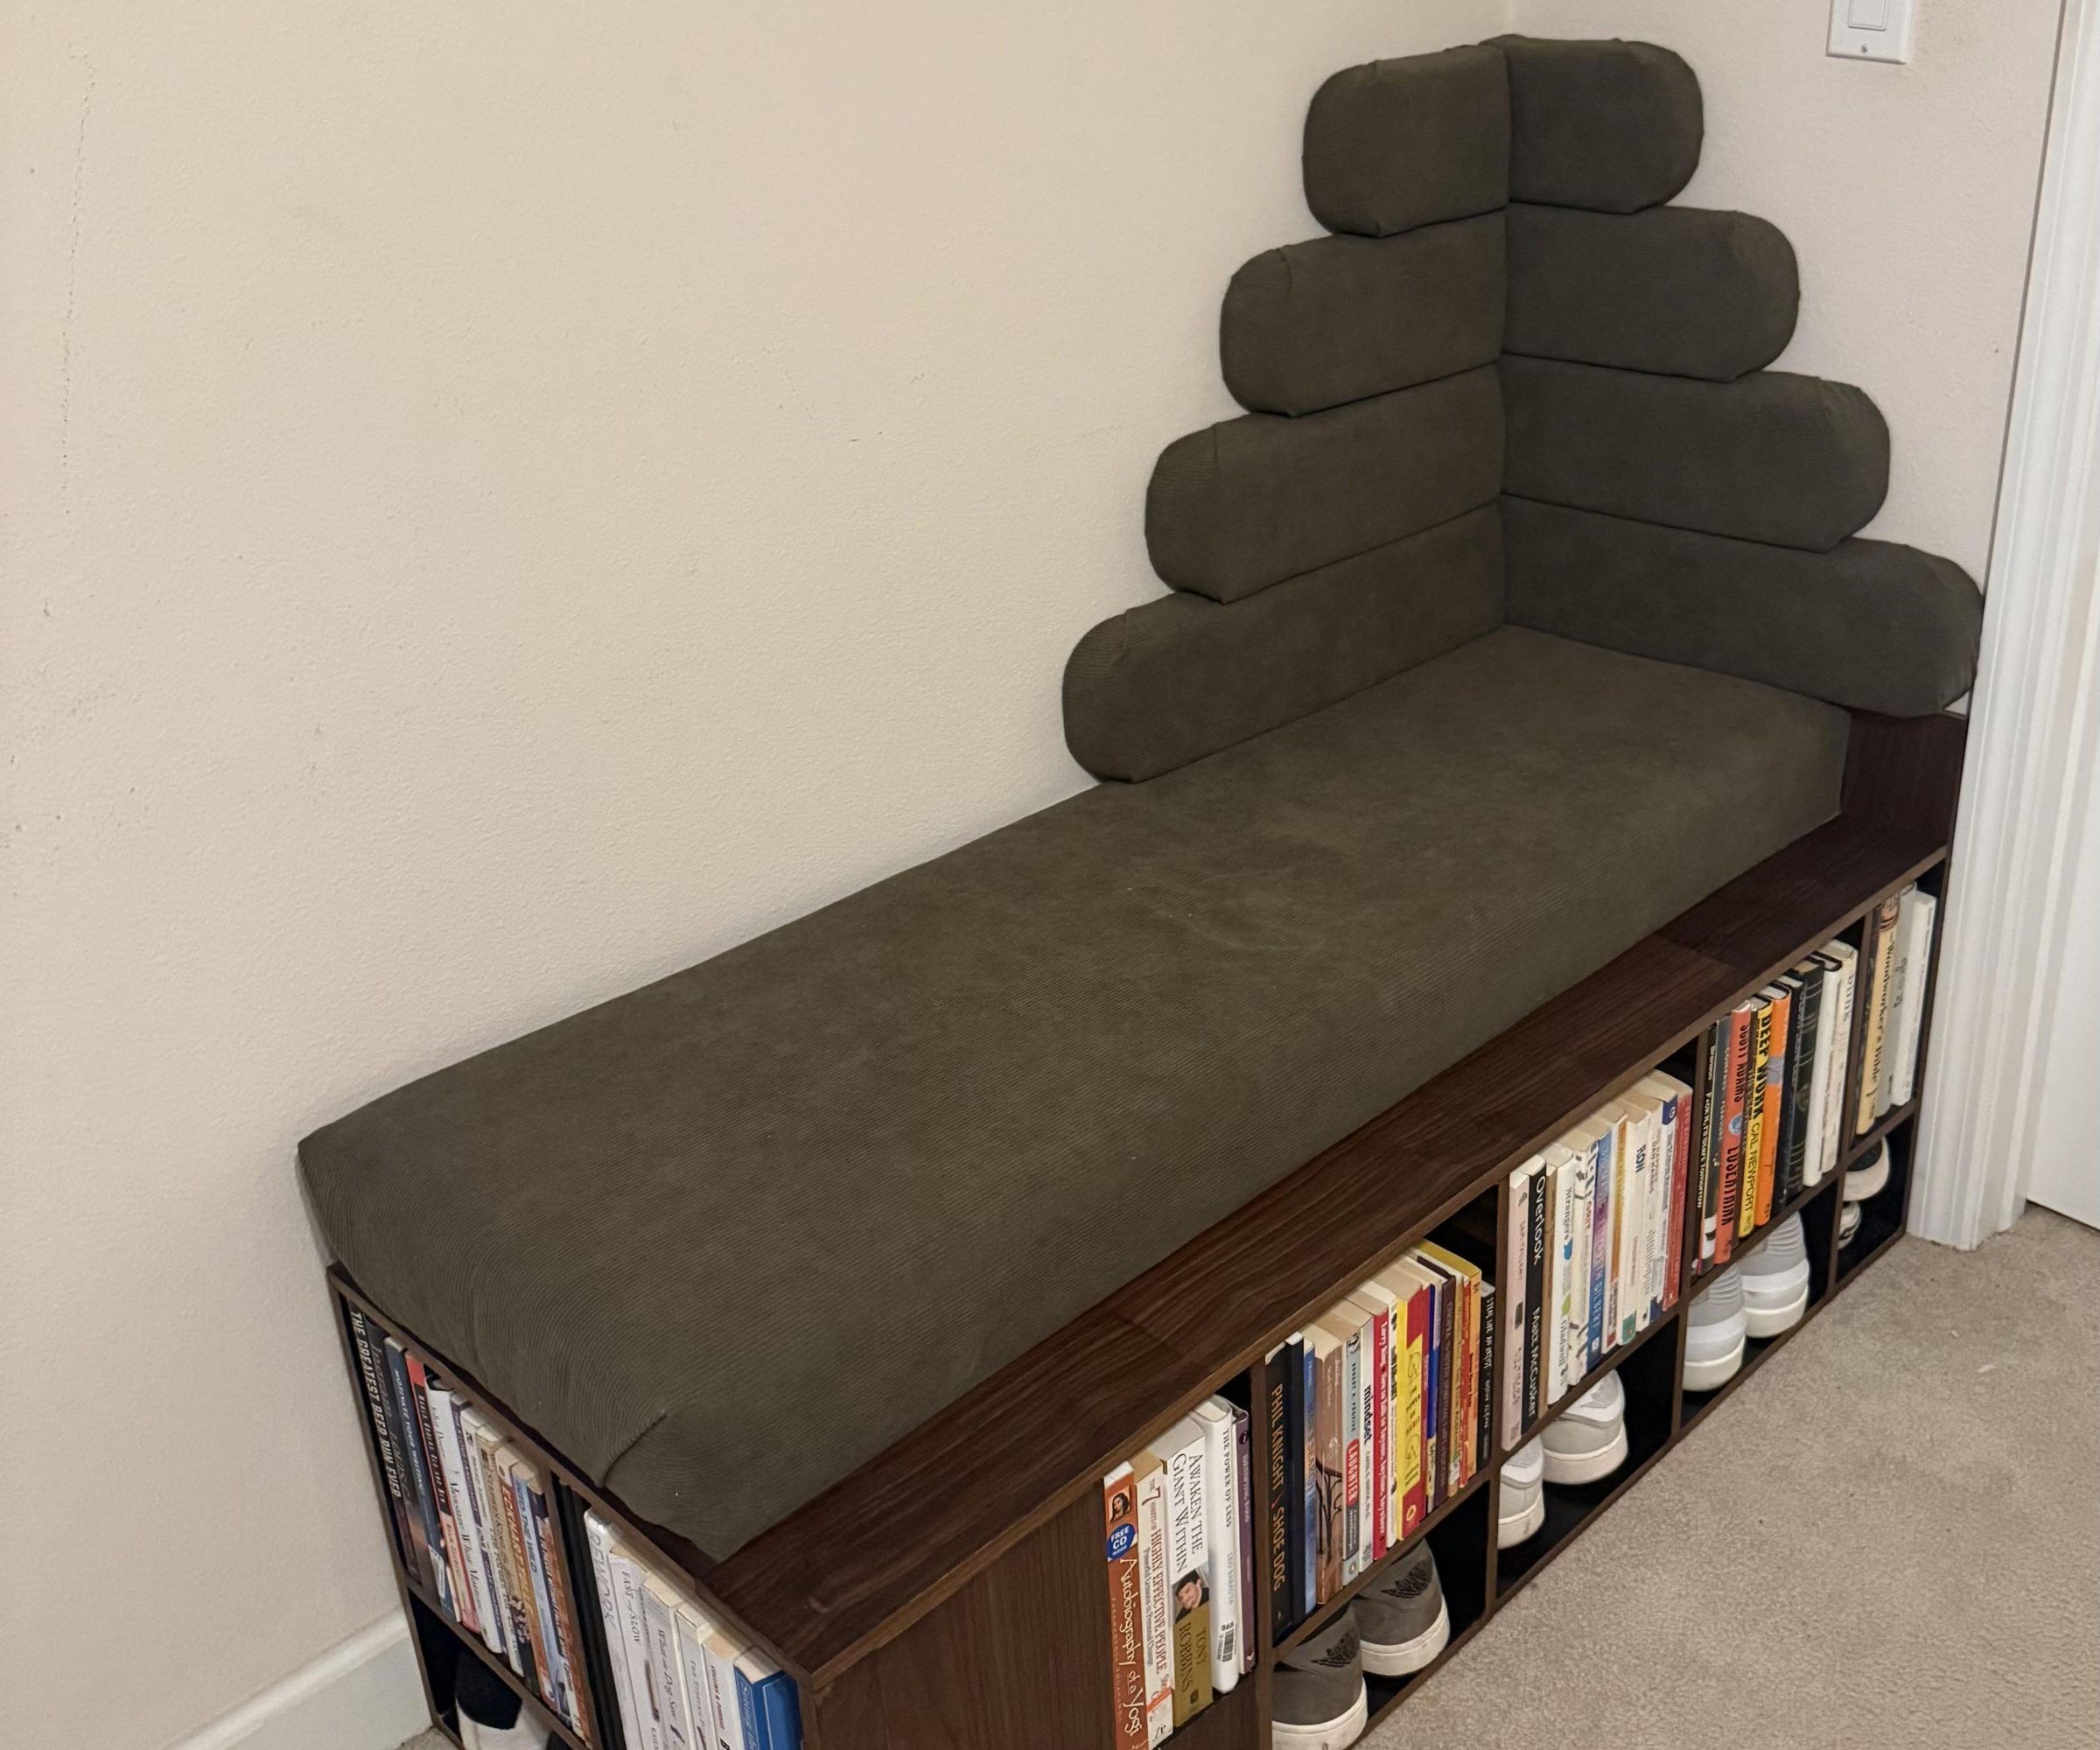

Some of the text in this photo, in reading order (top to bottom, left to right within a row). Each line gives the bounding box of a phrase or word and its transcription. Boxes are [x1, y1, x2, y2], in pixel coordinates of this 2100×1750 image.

[1734, 1025, 1749, 1102] SCOTT ADAMS
[1753, 1014, 1772, 1120] DEEP WORK
[1635, 1144, 1646, 1172] FLOW
[1745, 1123, 1761, 1212] CAL NEWPORT
[1533, 1175, 1546, 1266] Overlook
[1563, 1187, 1573, 1241] Strangers
[350, 1311, 366, 1335] THE
[1592, 1283, 1604, 1328] GILBERT
[1378, 1321, 1388, 1346] Larry
[1558, 1320, 1568, 1366] Gladwell
[357, 1337, 382, 1402] GREATEST
[1528, 1306, 1540, 1418] Matt McCusker
[371, 1403, 388, 1437] BEER
[395, 1368, 411, 1420] MOTIVATE
[405, 1422, 416, 1448] YOUR
[1363, 1385, 1374, 1446] mindset
[378, 1437, 396, 1465] RUN
[1270, 1383, 1284, 1491] PHIL KNIGHT
[386, 1466, 402, 1499] EVER
[1141, 1487, 1161, 1506] 7
[1223, 1488, 1231, 1500] OF
[1347, 1442, 1359, 1502] LAUGHTER
[448, 1481, 465, 1530] Measure
[459, 1534, 474, 1563] What
[501, 1486, 522, 1551] ECKHART
[521, 1513, 533, 1540] THE
[1172, 1453, 1190, 1573] GIANT WITHIN
[1189, 1454, 1204, 1554] AWAKEN THE
[525, 1541, 538, 1574] WILD
[1110, 1525, 1130, 1542] FREE
[1112, 1536, 1128, 1550] CD
[1151, 1529, 1163, 1573] HIGHLY
[1272, 1506, 1285, 1592] SHOE DOG
[589, 1530, 614, 1626] REWORK
[1143, 1547, 1152, 1577] Powerful
[622, 1572, 634, 1599] FAST
[629, 1614, 641, 1645] SLOW
[1119, 1558, 1142, 1666] Autobiography
[1144, 1578, 1152, 1604] Lessons
[1152, 1572, 1166, 1633] EFFECTIVE
[1179, 1625, 1194, 1692] ROBBINS
[1195, 1628, 1208, 1664] TONY
[658, 1628, 678, 1720] What Dog Saw
[710, 1665, 719, 1694] COLLINS
[1128, 1670, 1140, 1684] of
[1129, 1684, 1137, 1694] a
[742, 1685, 753, 1731] Setting
[1124, 1688, 1144, 1737] Yogi
